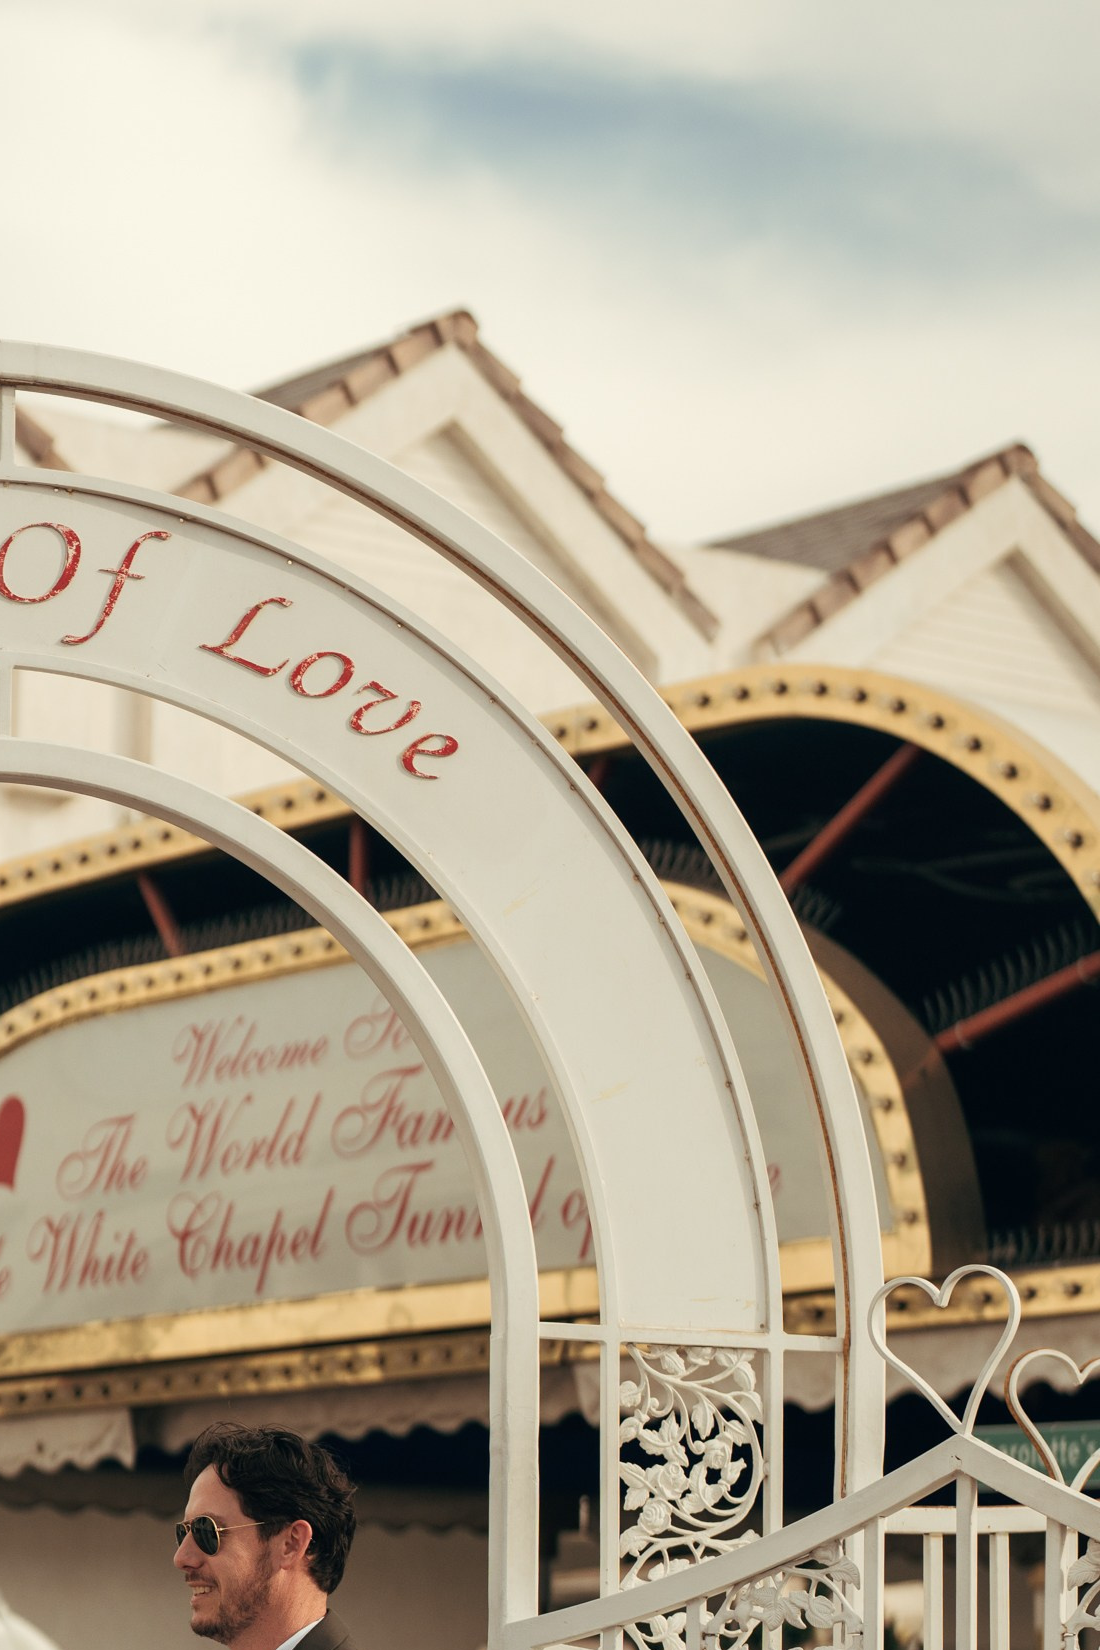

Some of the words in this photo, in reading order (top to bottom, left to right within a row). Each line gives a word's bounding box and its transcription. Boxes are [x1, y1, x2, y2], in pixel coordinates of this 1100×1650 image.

[200, 596, 460, 780] Love
[171, 1015, 330, 1088] Welcome
[56, 1113, 149, 1201] The
[165, 1092, 323, 1182] World
[330, 1062, 549, 1160] Famus
[26, 1207, 150, 1293] White
[165, 1185, 336, 1296] Chapel
[344, 1154, 556, 1258] Tunl
